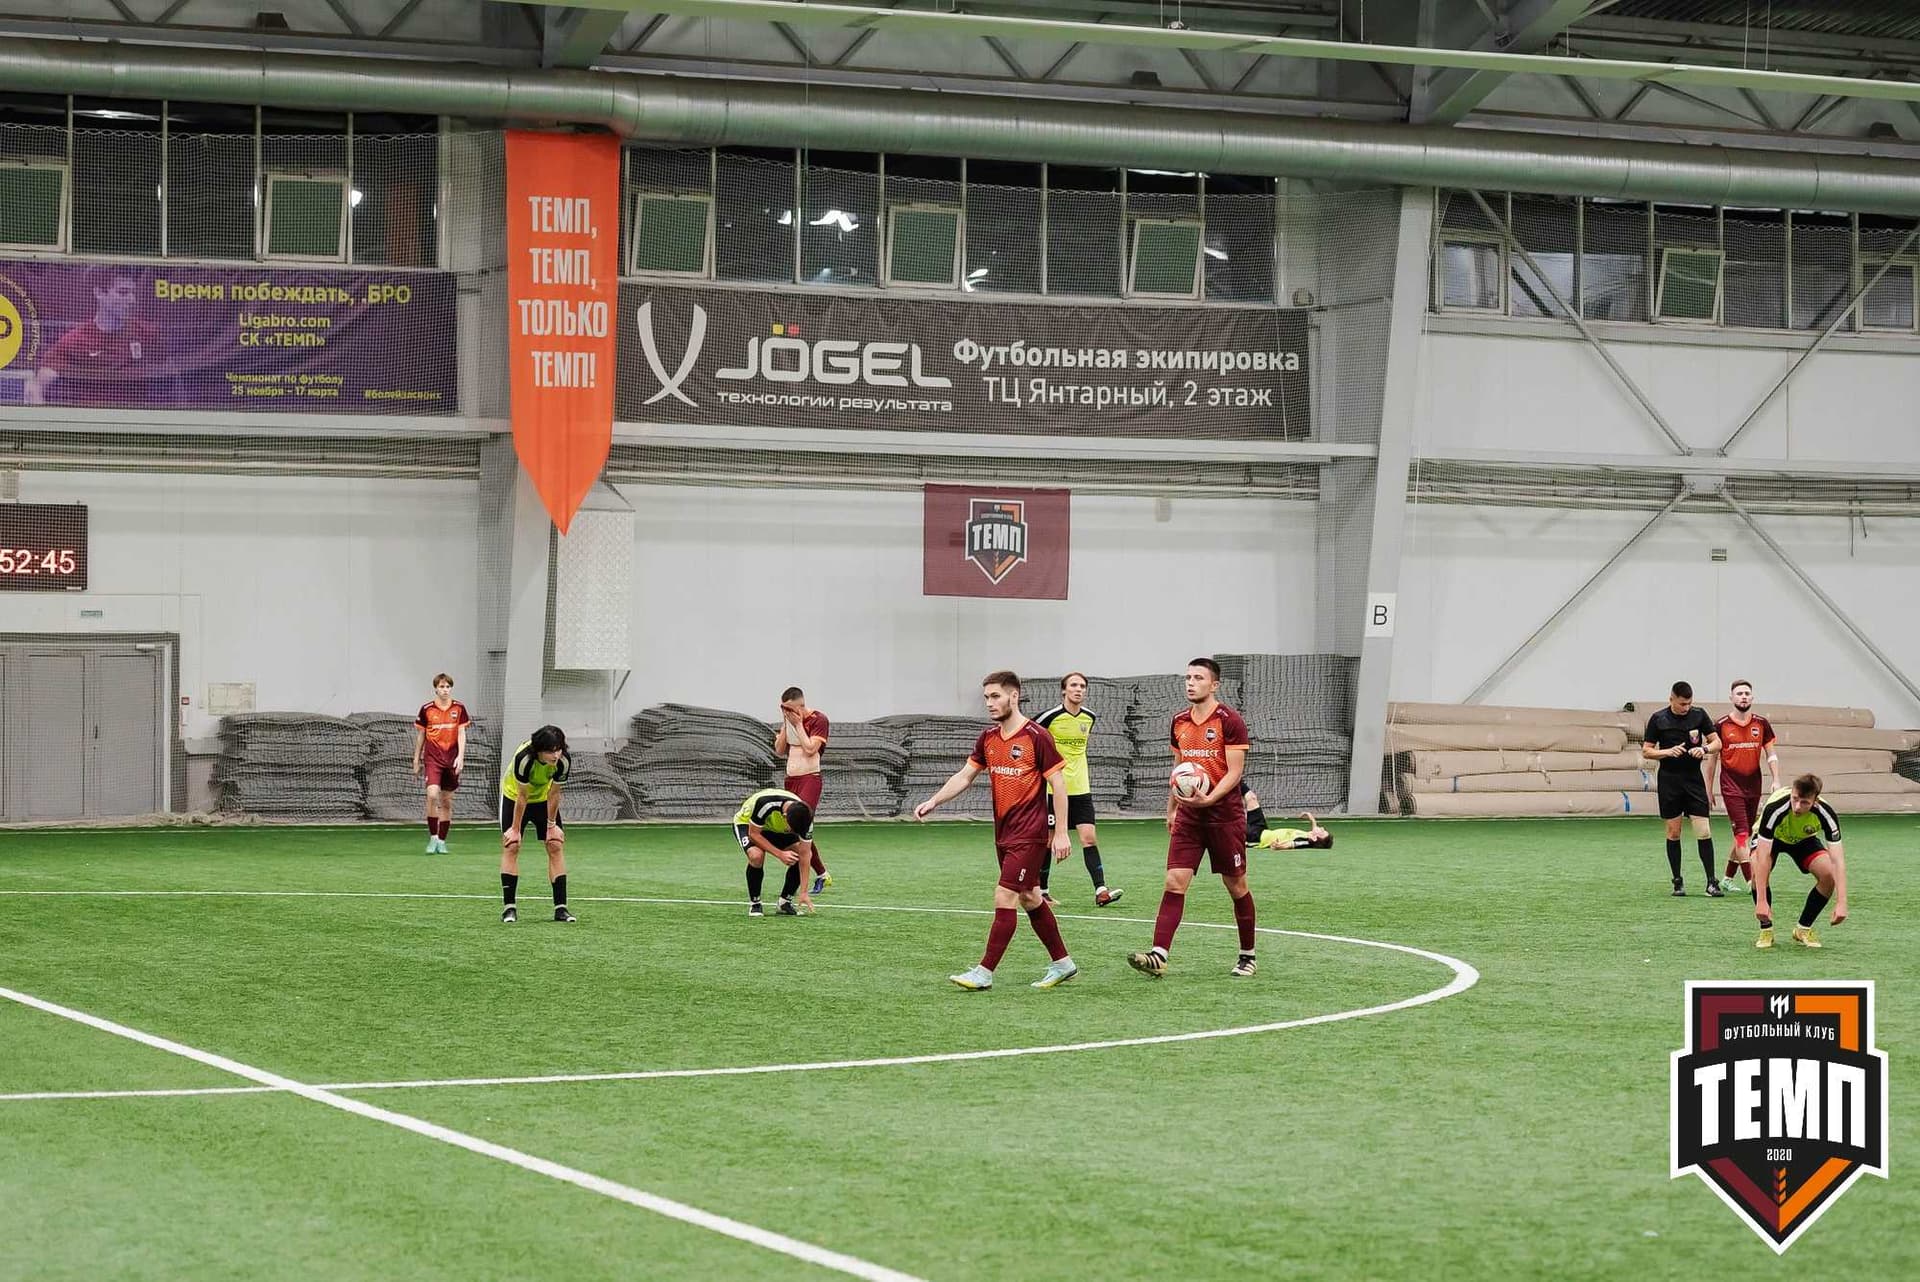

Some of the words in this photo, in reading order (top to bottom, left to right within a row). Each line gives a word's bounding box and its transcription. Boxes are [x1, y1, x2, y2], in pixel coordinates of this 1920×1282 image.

[528, 196, 597, 239] ТЕМП,
[529, 247, 596, 290] ТЕМП,
[155, 279, 224, 302] Время
[231, 283, 354, 305] побеждать,
[239, 313, 331, 329] Ligabro.com
[518, 299, 608, 338] ТОЛЬКО
[239, 332, 260, 346] СК
[265, 333, 326, 347] «ТЕМП»
[531, 351, 595, 388] ТЕМП!
[953, 338, 1129, 371] Футбольная
[1135, 348, 1300, 376] экипировка
[226, 372, 282, 384] Чемпионат
[284, 375, 296, 384] по
[247, 386, 284, 397] ноября
[308, 387, 339, 398] марта
[716, 391, 834, 408] технологии
[839, 397, 953, 413] результата
[983, 377, 1021, 408] ТЦ
[1029, 378, 1175, 410] Янтарный,
[1183, 381, 1198, 407] 2
[1207, 387, 1273, 407] этаж
[972, 523, 1022, 553] ТЕМП
[0, 549, 76, 574] 52:45
